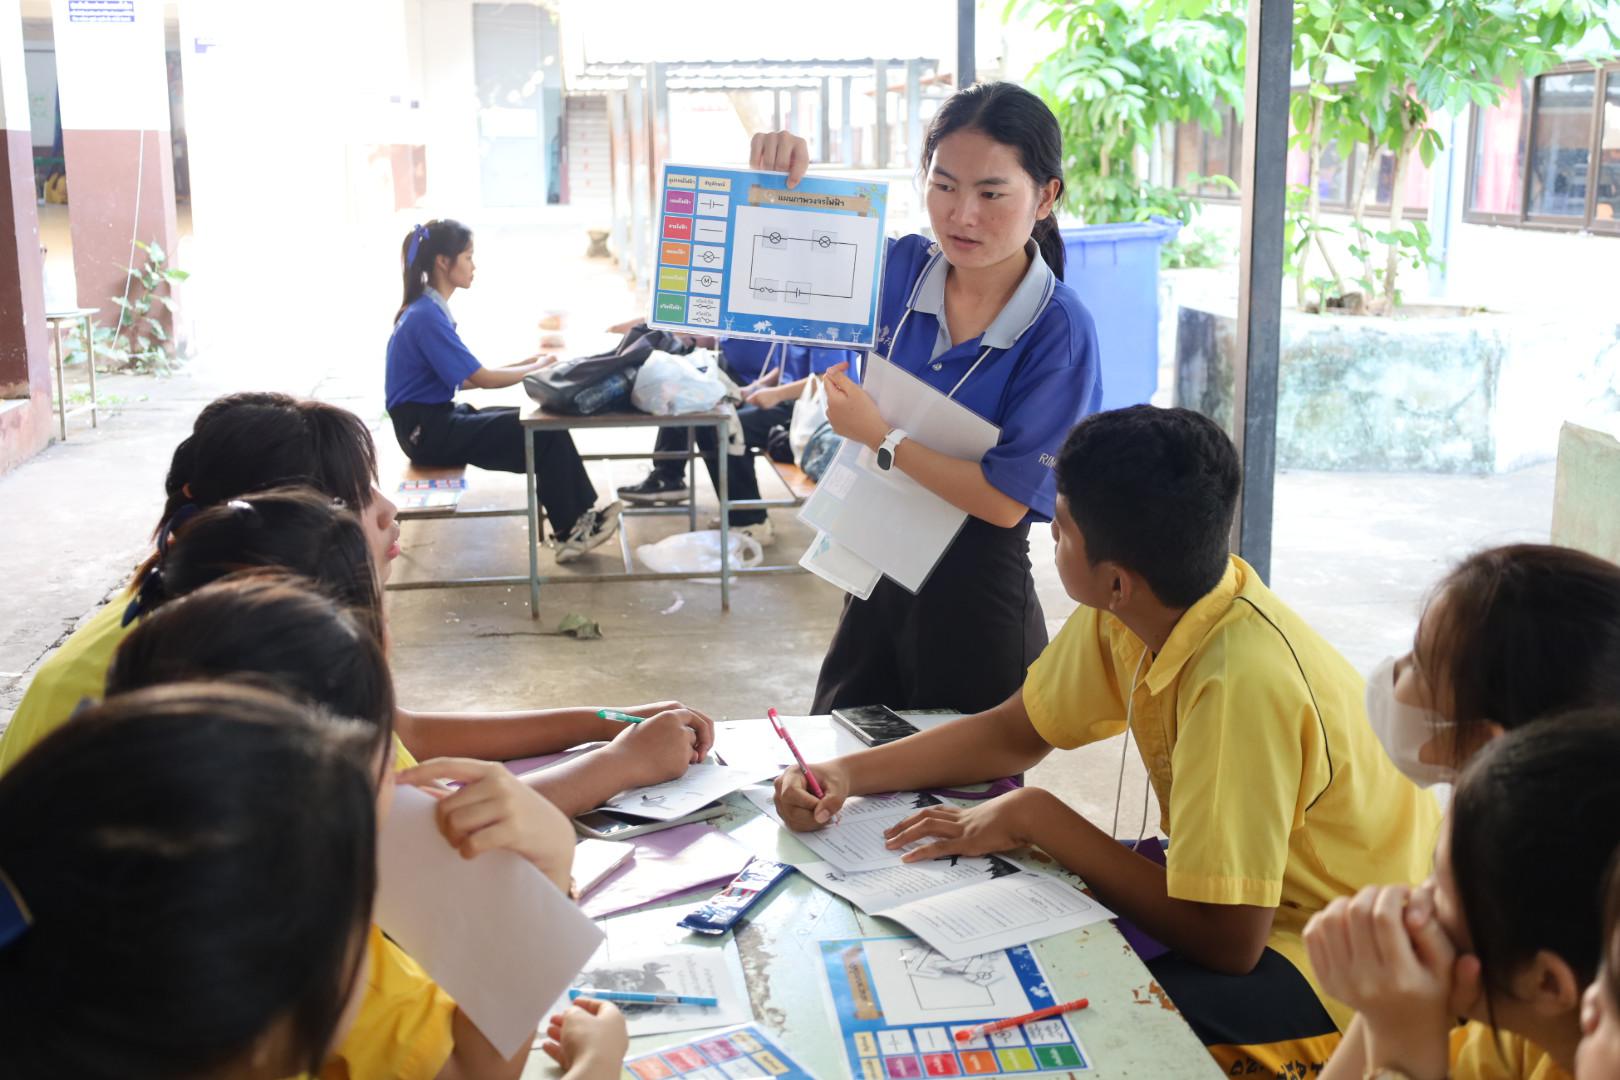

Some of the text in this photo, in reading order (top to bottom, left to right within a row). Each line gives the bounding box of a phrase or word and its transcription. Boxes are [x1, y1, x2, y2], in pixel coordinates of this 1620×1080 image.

[777, 194, 845, 207] แผนภาพวงจรไฟฟ้า
